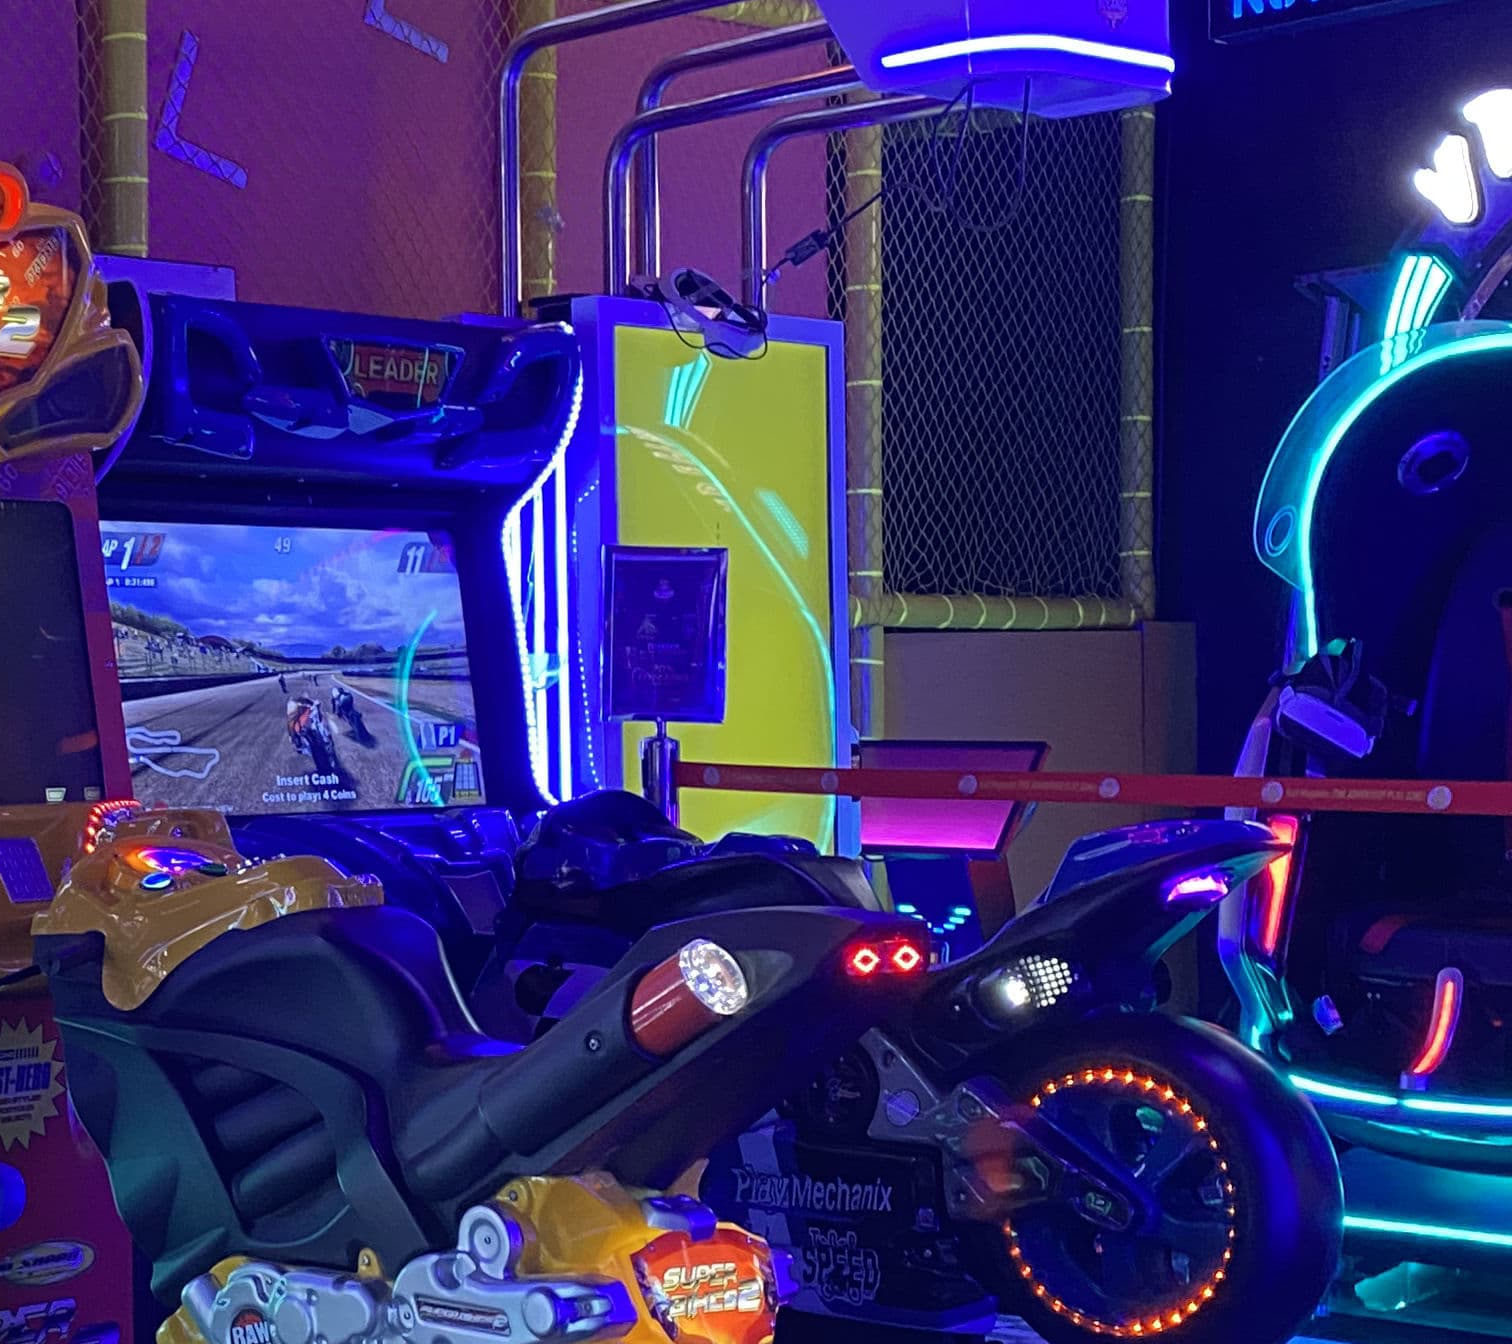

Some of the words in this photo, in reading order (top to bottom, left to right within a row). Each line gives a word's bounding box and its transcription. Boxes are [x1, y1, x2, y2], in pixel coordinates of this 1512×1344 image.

[353, 353, 438, 385] LEADER
[276, 775, 310, 787] Insert
[312, 773, 339, 785] Cash
[262, 792, 285, 803] Cost
[287, 792, 296, 802] to
[323, 790, 329, 799] 4
[663, 1262, 737, 1291] SUPER
